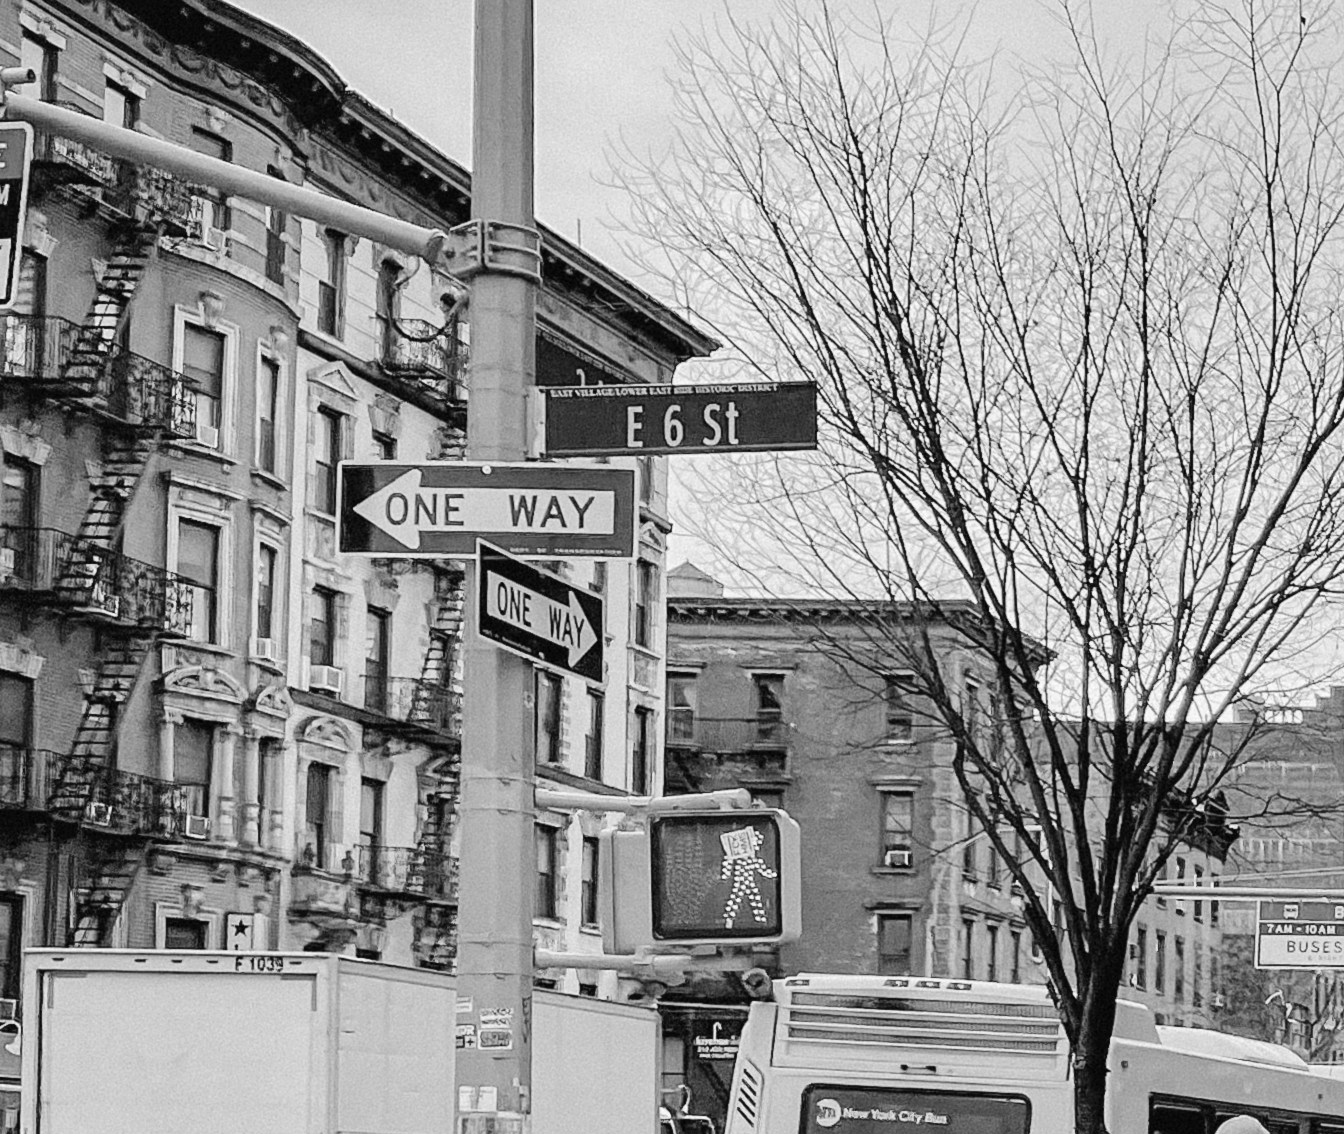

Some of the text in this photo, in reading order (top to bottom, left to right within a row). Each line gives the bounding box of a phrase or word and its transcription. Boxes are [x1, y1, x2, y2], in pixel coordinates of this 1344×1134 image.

[626, 401, 740, 448] E 6 St
[385, 492, 595, 529] ONE WAY
[497, 581, 532, 628] ONE
[549, 604, 585, 649] WAY
[1266, 923, 1293, 935] 7AM
[1305, 924, 1337, 936] 10AM
[1286, 941, 1343, 954] BUSES
[842, 1107, 949, 1125] New York City Bus
